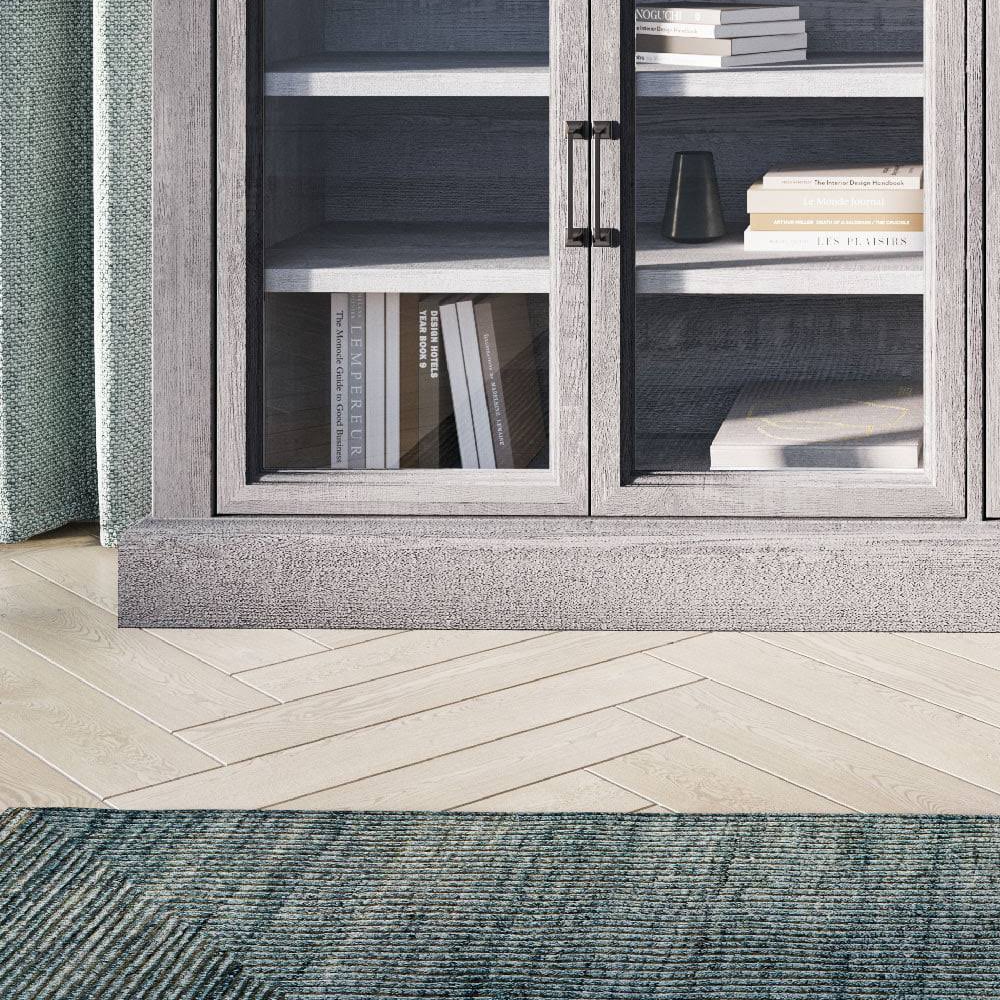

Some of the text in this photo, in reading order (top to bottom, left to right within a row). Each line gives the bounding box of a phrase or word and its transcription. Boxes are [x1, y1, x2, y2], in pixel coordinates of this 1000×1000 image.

[849, 179, 871, 187] Design
[817, 236, 840, 246] LES
[847, 236, 908, 246] PLAISIRS
[419, 310, 427, 333] YEAR
[419, 335, 427, 360] BOOK
[430, 310, 439, 379] DESIGN HOTELS
[335, 310, 344, 464] The Monocle Guide to Good Business
